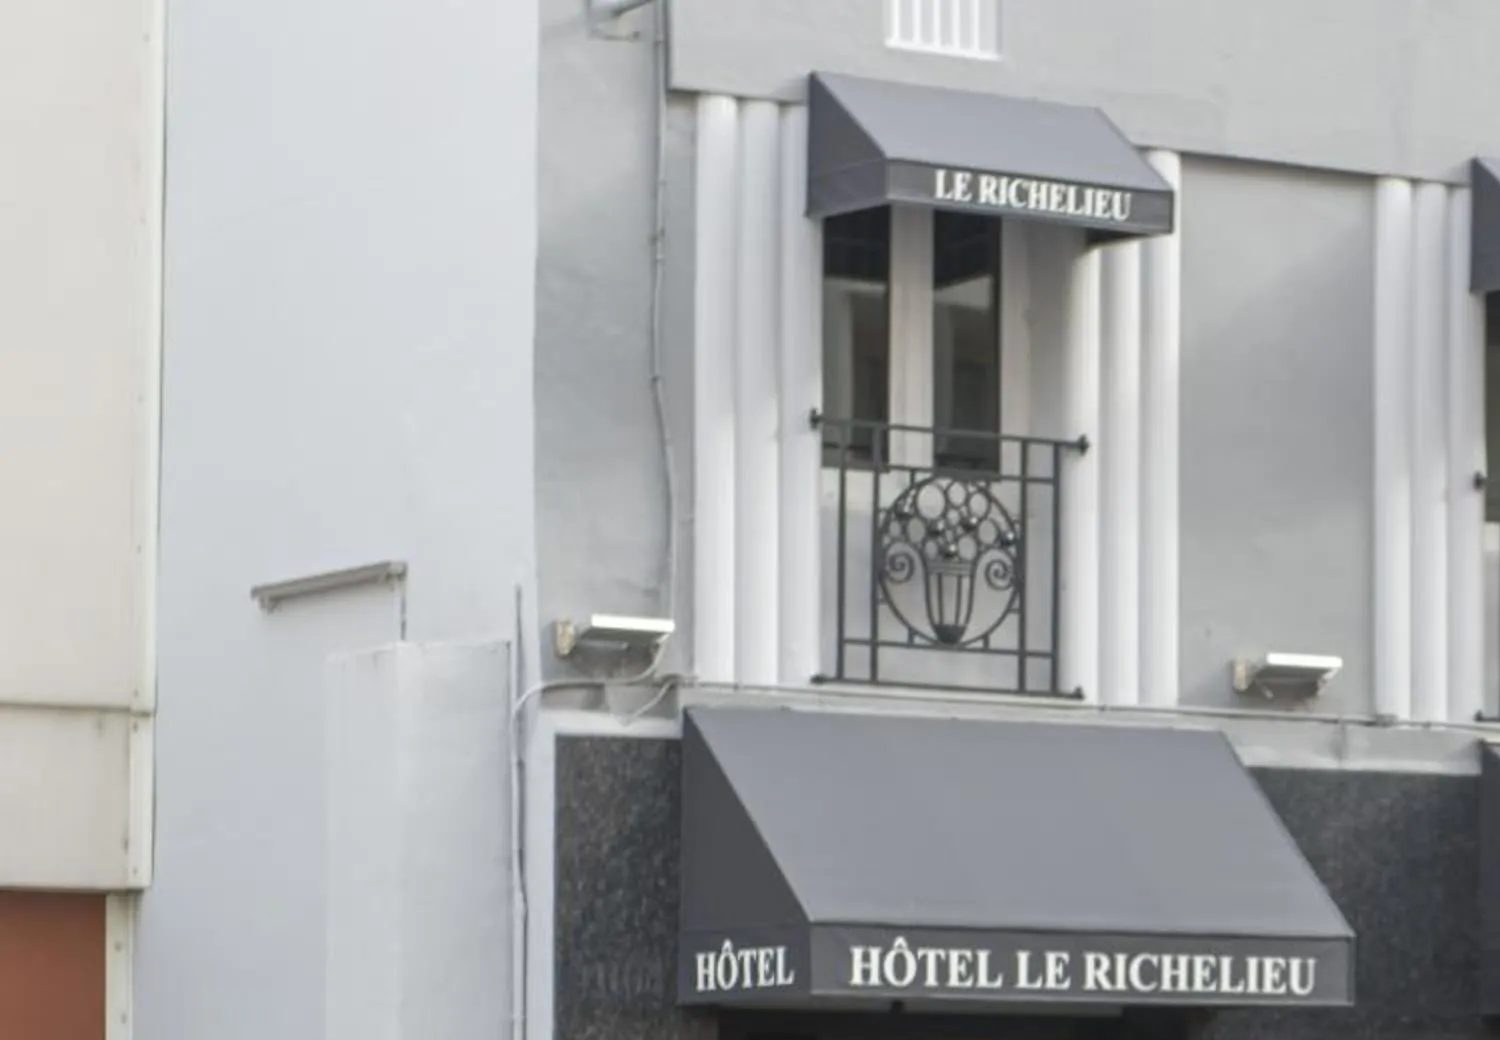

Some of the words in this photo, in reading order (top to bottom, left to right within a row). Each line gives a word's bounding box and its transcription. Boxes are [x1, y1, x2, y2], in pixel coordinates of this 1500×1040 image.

[935, 169, 972, 202] LE
[978, 175, 1132, 222] RICHELIEU
[696, 939, 795, 992] HÔTEL
[849, 936, 1003, 989] HÔTEL
[1016, 950, 1071, 990] LE
[1084, 952, 1317, 996] RICHELIEU
